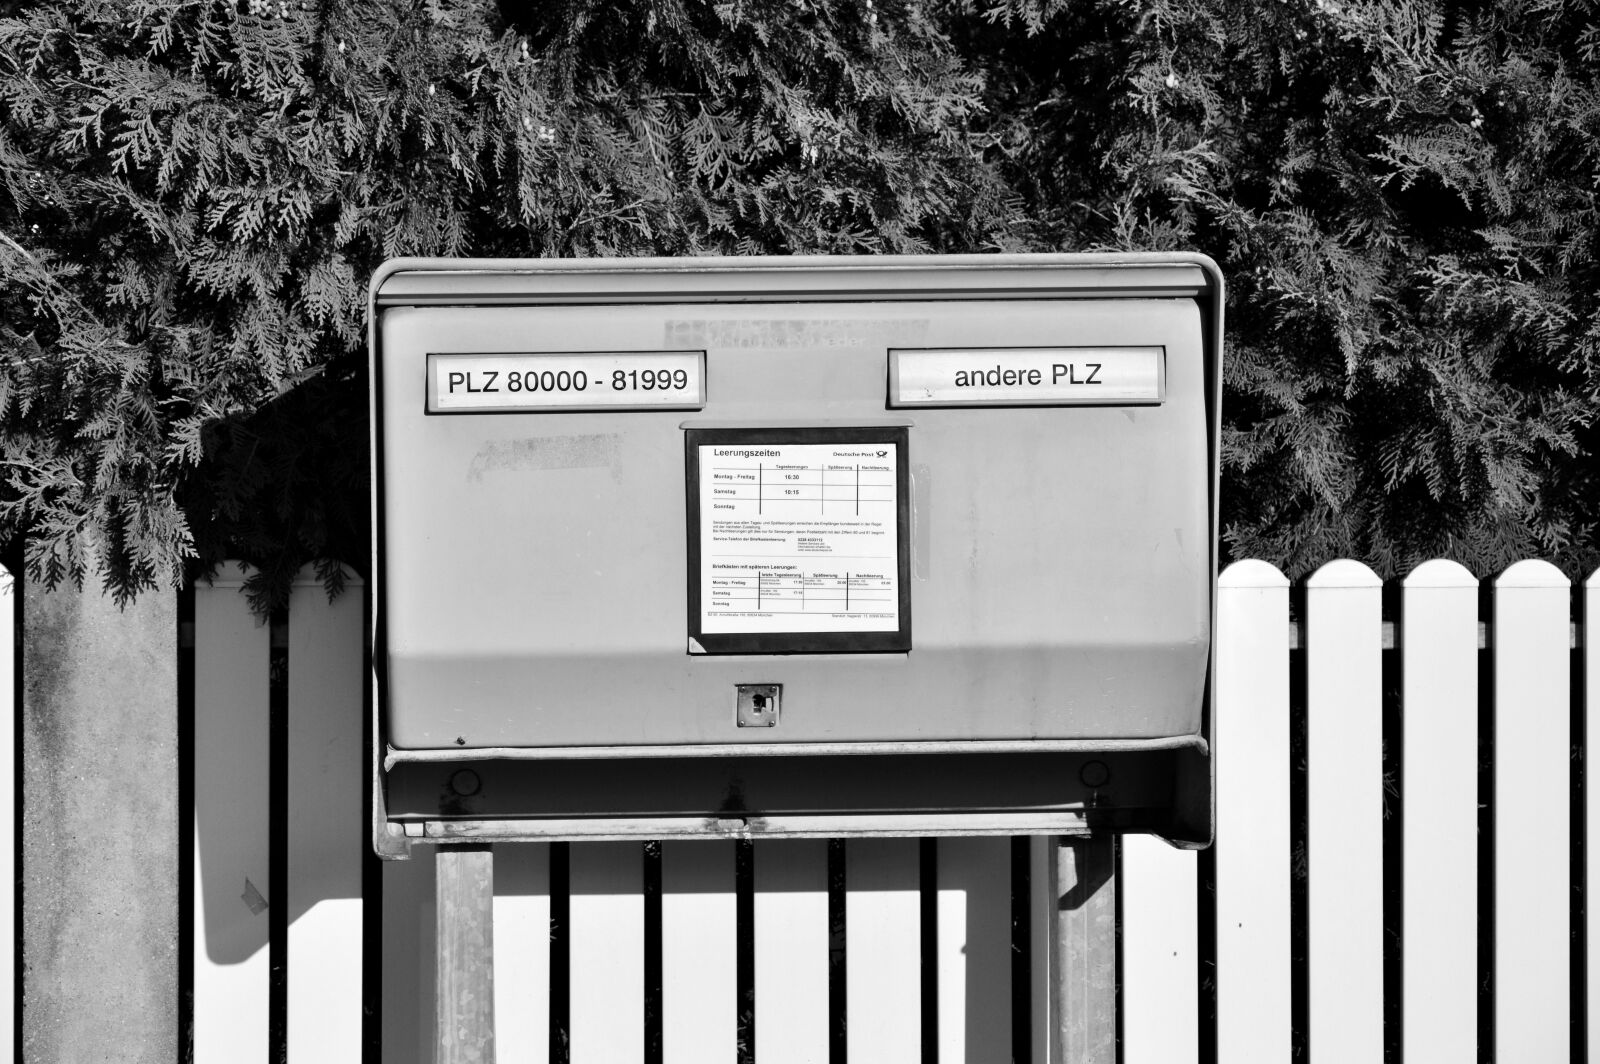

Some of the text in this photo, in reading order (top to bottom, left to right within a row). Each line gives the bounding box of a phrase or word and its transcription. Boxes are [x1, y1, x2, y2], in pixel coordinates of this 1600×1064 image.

[448, 371, 500, 393] PLZ
[507, 370, 588, 393] 80000
[611, 369, 688, 391] 81999
[954, 363, 1102, 387] andere PLZ
[713, 448, 781, 459] Leerungszeiten
